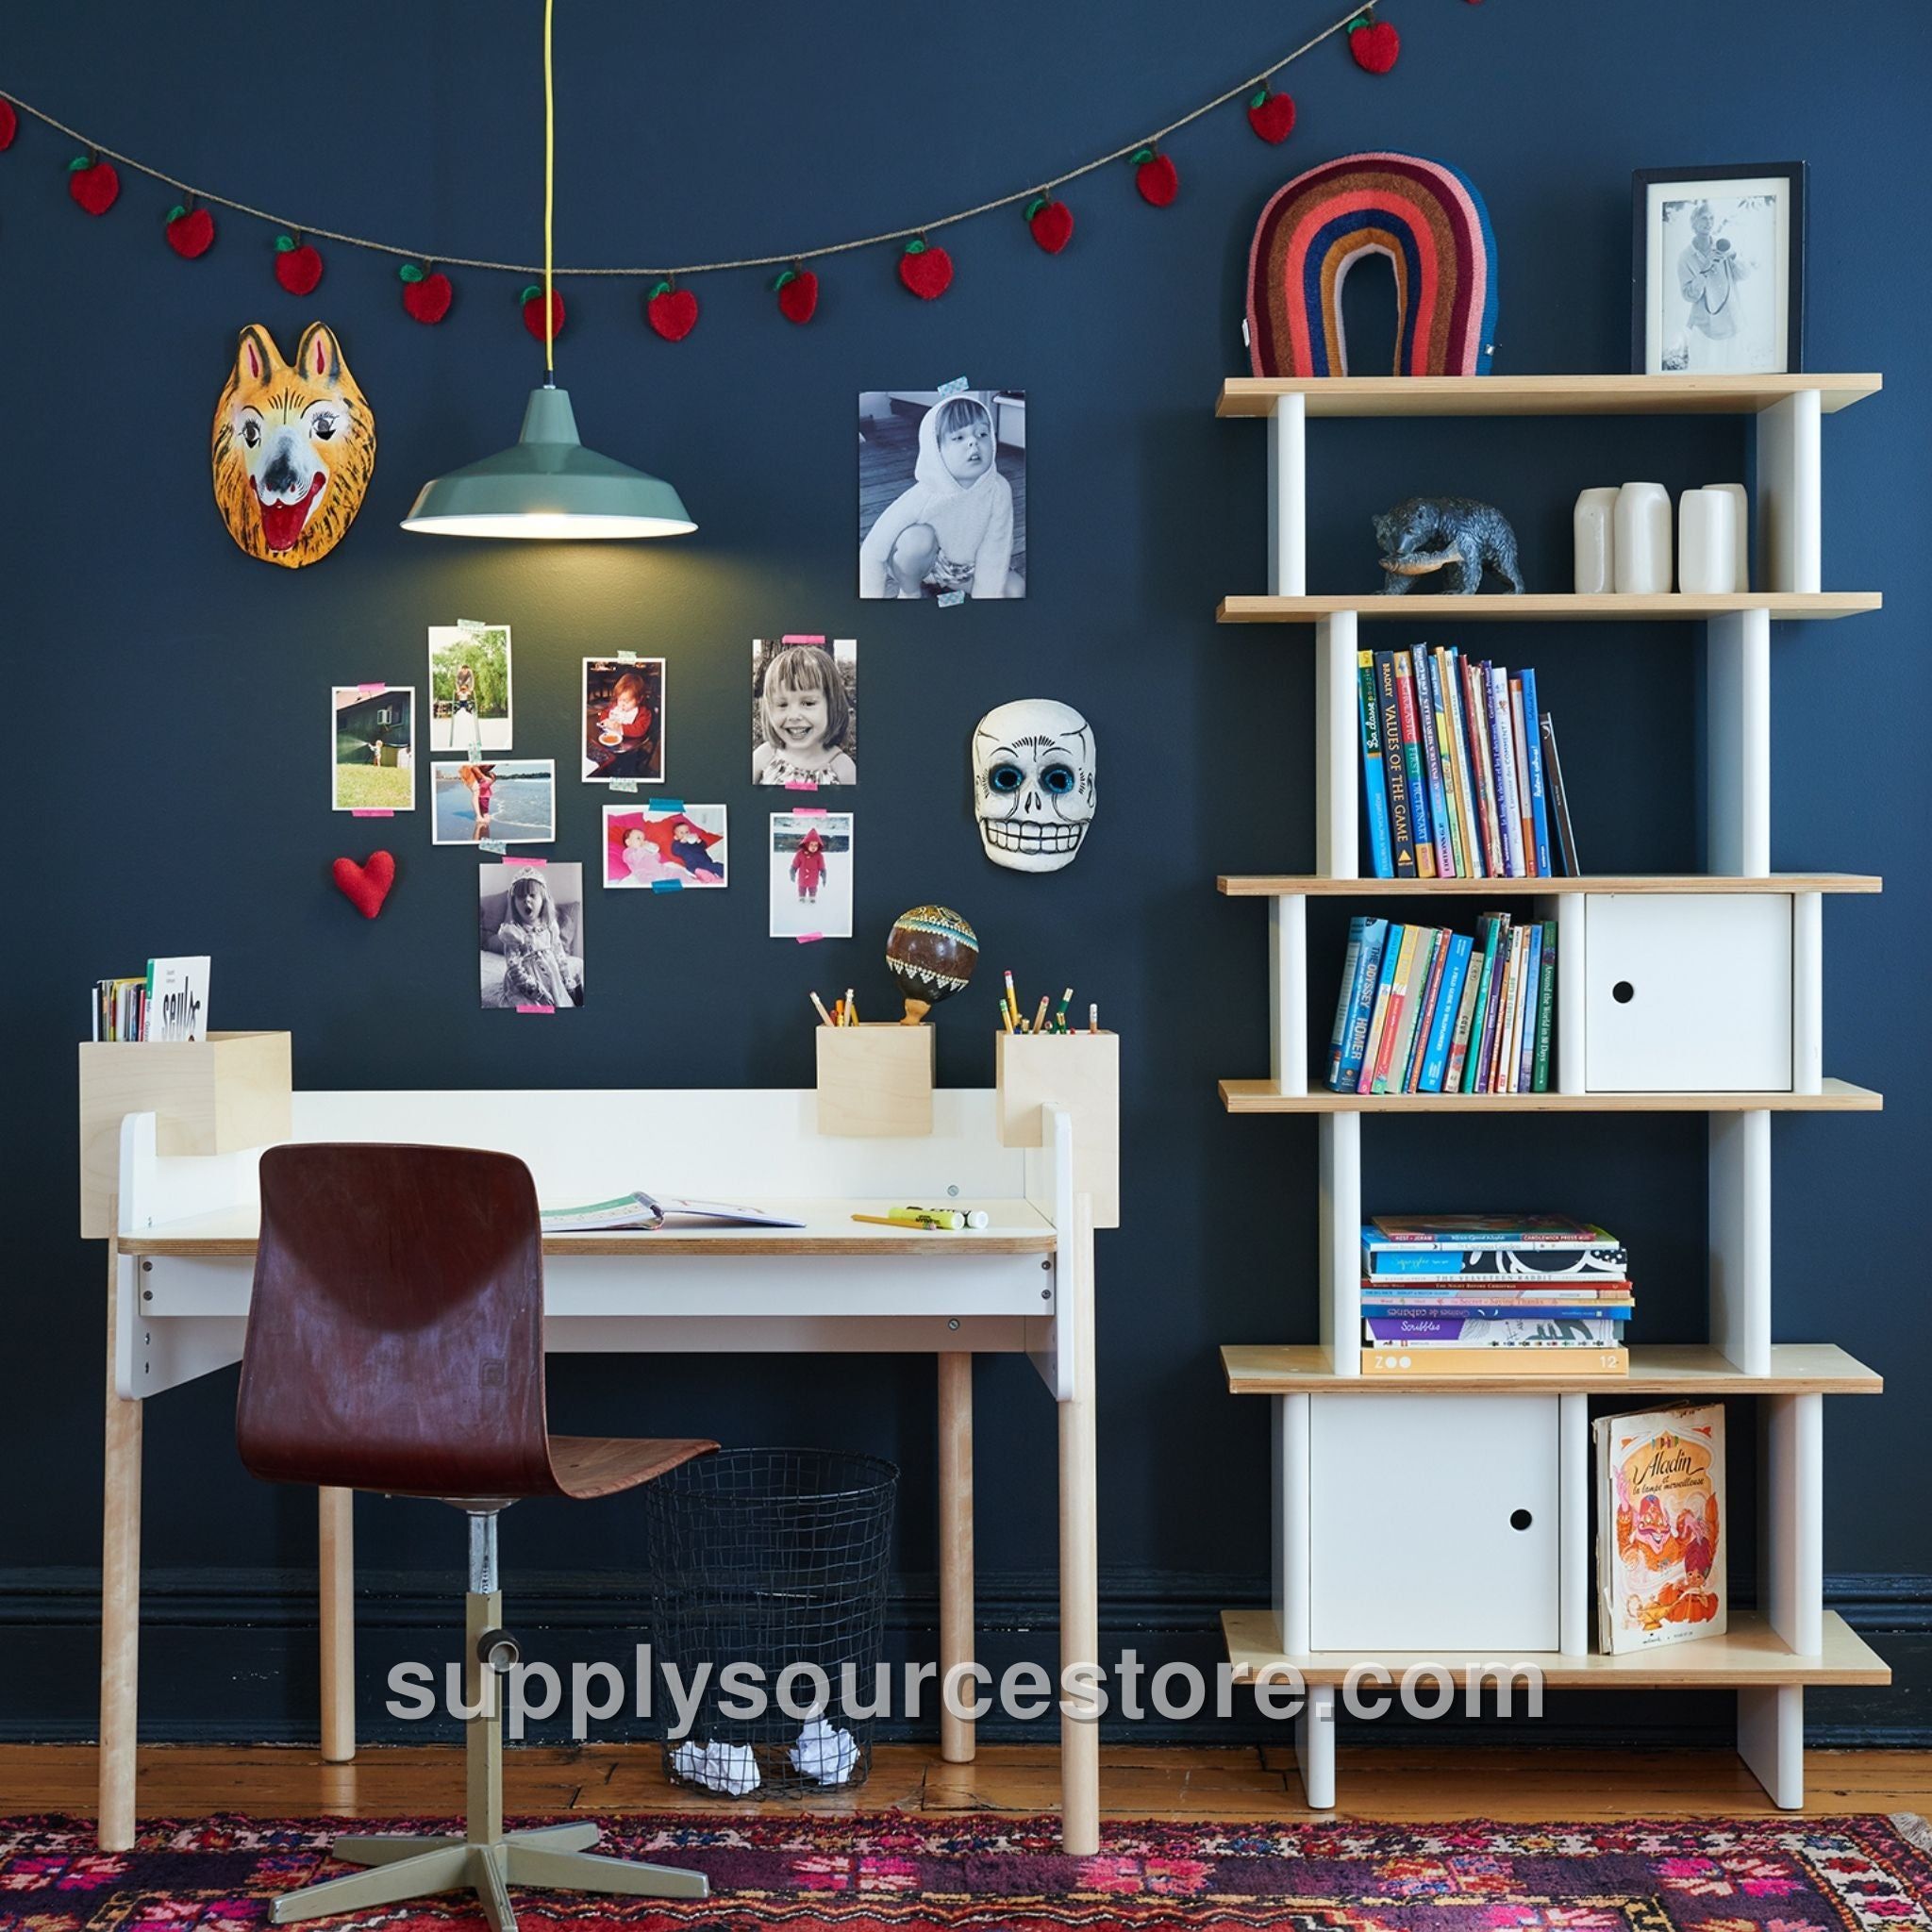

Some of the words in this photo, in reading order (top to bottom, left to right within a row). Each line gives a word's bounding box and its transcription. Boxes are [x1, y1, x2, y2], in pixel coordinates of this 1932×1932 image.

[1382, 662, 1392, 697] BRADLEY
[1400, 678, 1415, 739] SCHOLASTIC
[1384, 705, 1399, 750] VALUES
[1389, 753, 1401, 771] OF
[1407, 746, 1420, 774] FIRST
[1391, 774, 1404, 802] THE
[1393, 804, 1408, 841] GAME
[1412, 781, 1426, 841] DICTIONARY
[1369, 946, 1380, 964] THE
[1359, 963, 1377, 1008] ODYSSEY
[1543, 964, 1554, 991] Around
[1542, 992, 1552, 1004] the
[1541, 1006, 1551, 1025] World
[1349, 1017, 1368, 1059] HOMER
[1536, 1044, 1548, 1061] Days
[1388, 1308, 1426, 1318] cabanes
[1401, 1321, 1441, 1332] Scribbles
[1600, 1355, 1617, 1368] 12
[1633, 1448, 1705, 1486] Aladin
[1632, 1484, 1641, 1495] la
[1641, 1484, 1662, 1494] lampe
[1663, 1477, 1705, 1491] merveilleuse
